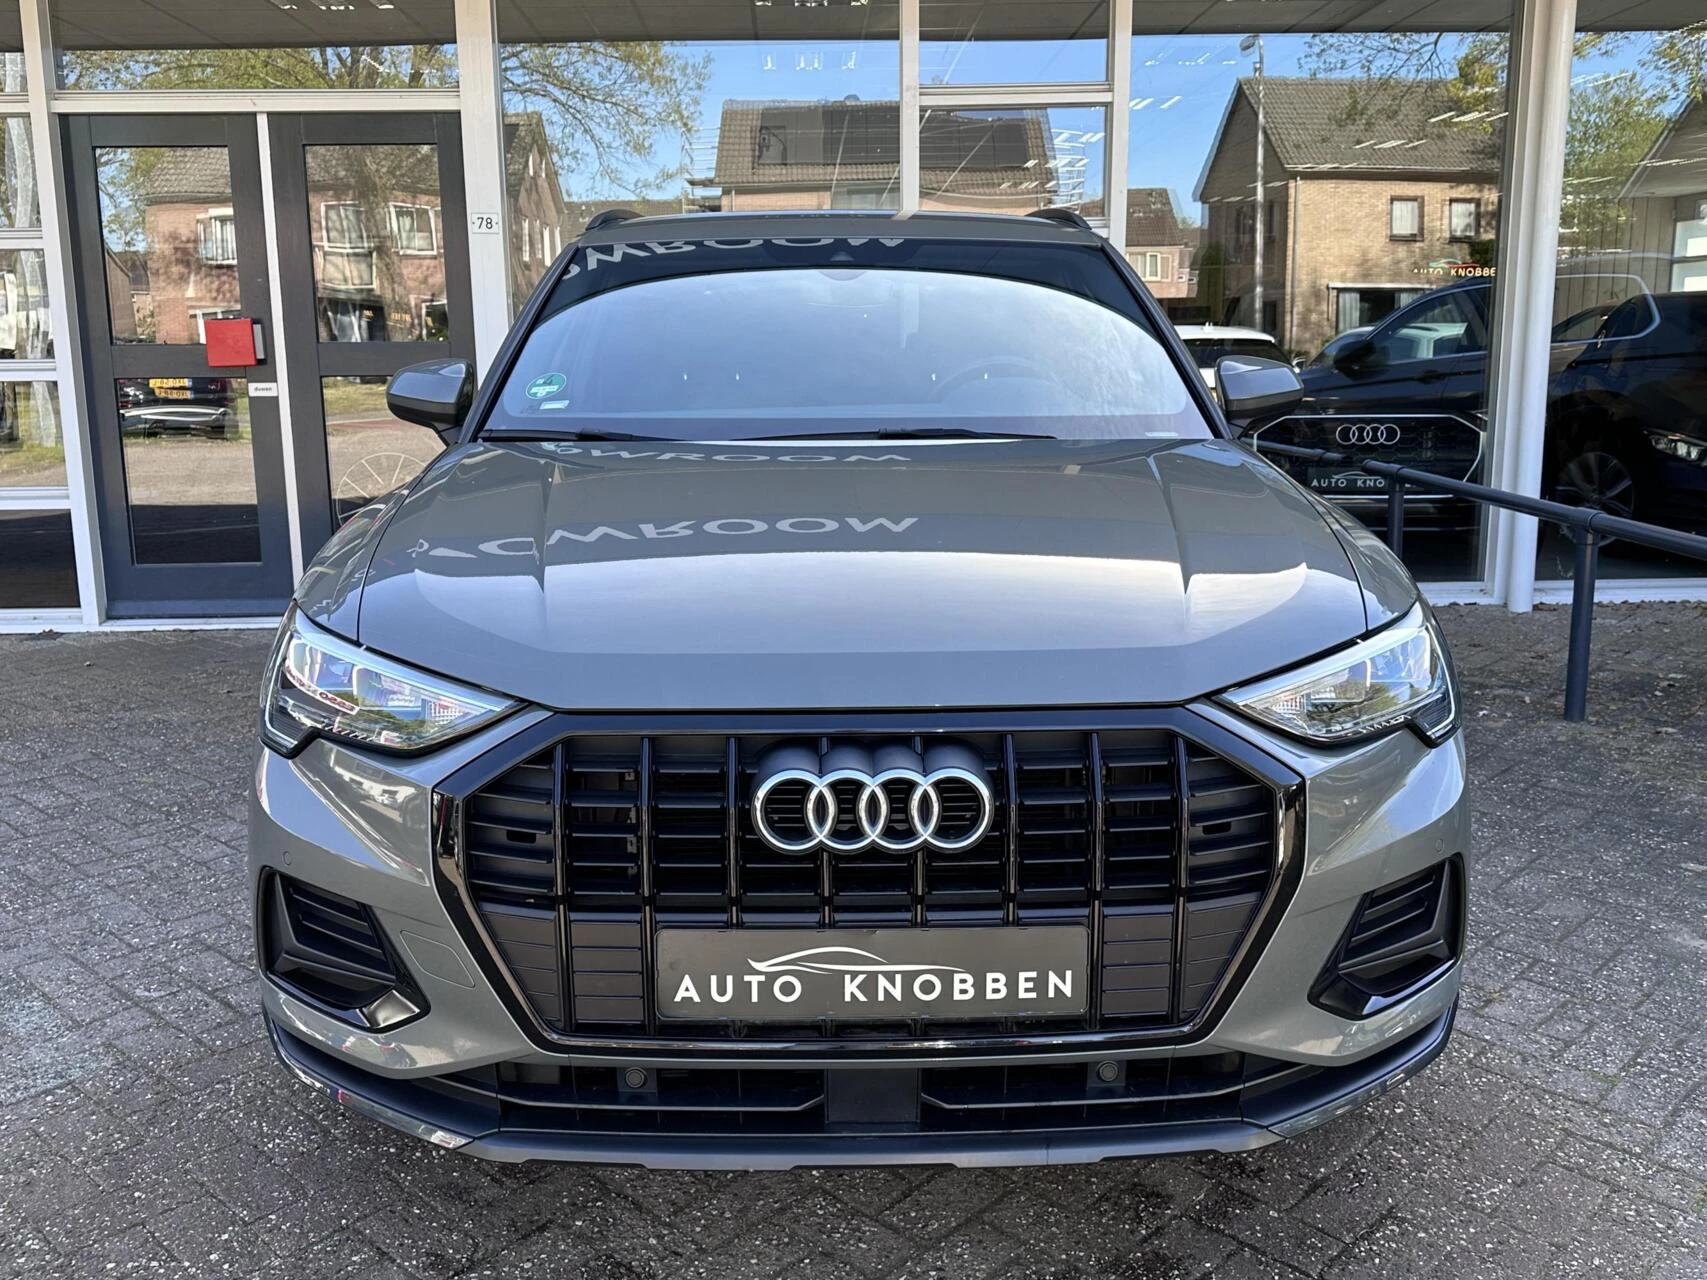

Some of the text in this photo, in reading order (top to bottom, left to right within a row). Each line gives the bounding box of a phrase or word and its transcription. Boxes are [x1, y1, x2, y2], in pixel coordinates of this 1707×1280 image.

[476, 216, 493, 230] 78
[1311, 479, 1347, 487] AUTO
[673, 969, 1072, 1003] AUTO KNOBBEN
